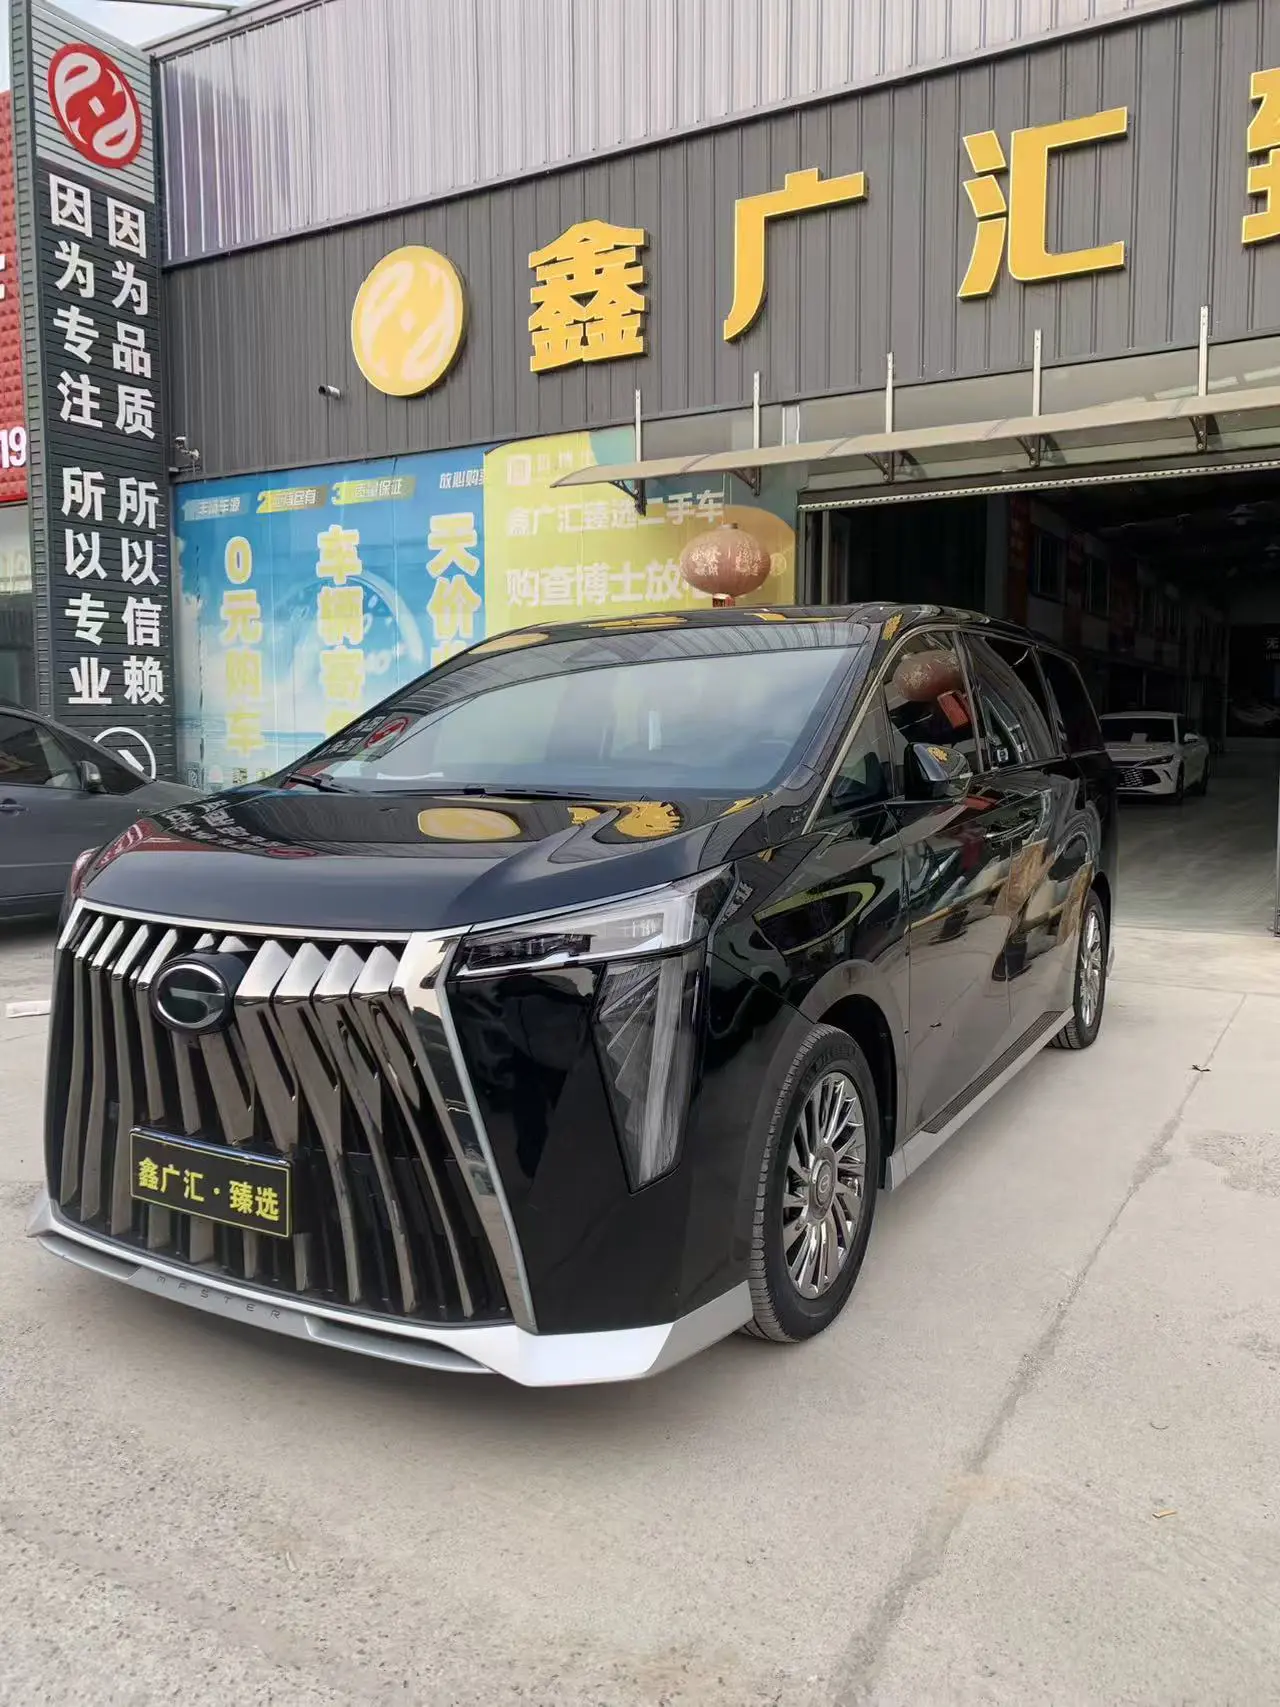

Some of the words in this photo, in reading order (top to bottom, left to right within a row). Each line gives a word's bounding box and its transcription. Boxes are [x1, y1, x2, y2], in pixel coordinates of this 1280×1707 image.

[48, 174, 103, 428] 因为专注
[106, 197, 156, 440] 因为品质
[528, 67, 1280, 374] 鑫广汇
[61, 467, 112, 705] 所以专业
[117, 477, 165, 705] 所以信赖
[220, 535, 264, 758] 0元购车
[506, 558, 711, 608] 购查博士放
[138, 1156, 280, 1222] 鑫广汇·臻选
